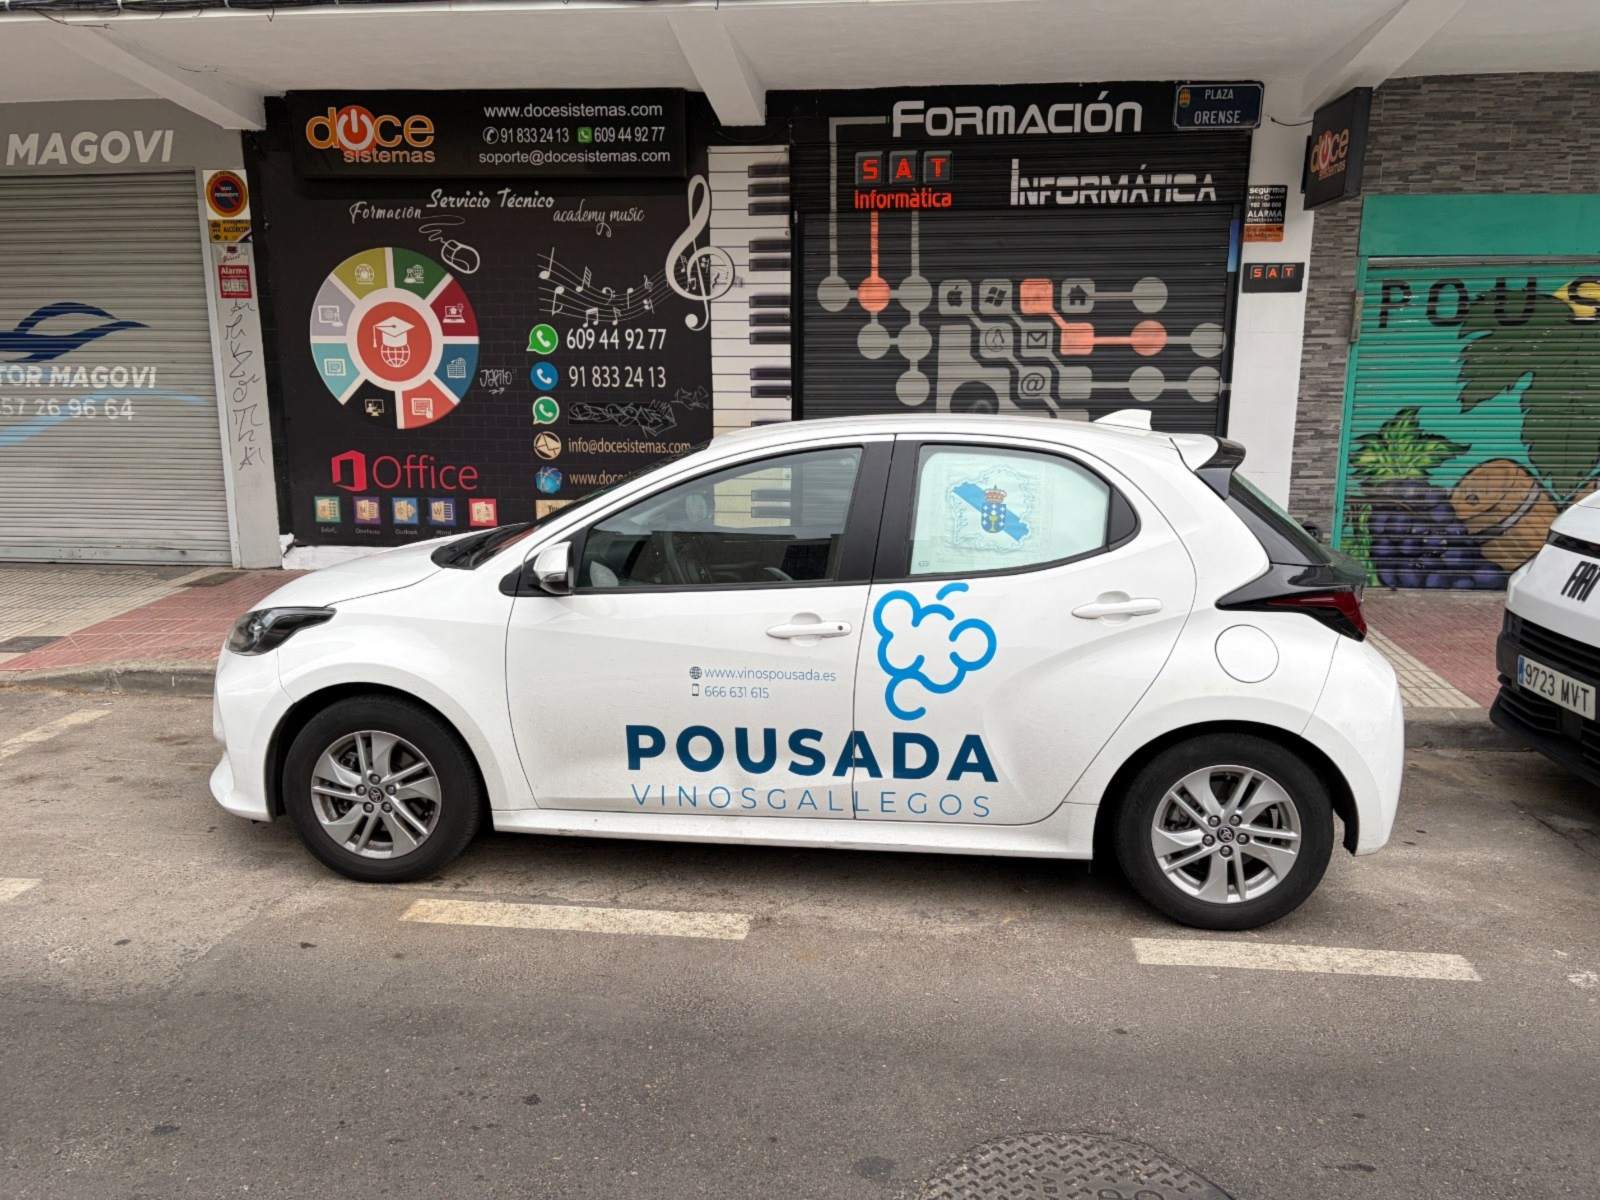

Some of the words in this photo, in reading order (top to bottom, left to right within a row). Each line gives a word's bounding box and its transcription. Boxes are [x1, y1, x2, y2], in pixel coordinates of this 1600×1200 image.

[1204, 88, 1234, 101] PLAZA
[483, 103, 663, 117] www.docesistemas.com
[892, 91, 1142, 137] FORMACIÓN
[1193, 110, 1242, 126] ORENSE
[500, 127, 514, 143] 91
[516, 127, 538, 143] 833
[539, 127, 554, 143] 24
[555, 127, 569, 143] 13
[594, 126, 616, 142] 609
[617, 126, 632, 142] 44
[634, 126, 649, 142] 92
[650, 126, 665, 142] 77
[6, 130, 174, 166] MAGOVI
[343, 149, 435, 163] sistemas
[479, 150, 670, 165] soporte@docesistemas.com
[1010, 158, 1218, 206] INFORMÁTICA
[426, 187, 490, 208] Servicio
[497, 188, 554, 208] Técnico
[553, 199, 612, 237] academy
[610, 207, 645, 222] music
[1247, 210, 1282, 218] ALARMA
[566, 329, 595, 350] 609
[599, 329, 620, 350] 44
[624, 329, 645, 350] 92
[647, 329, 667, 350] 77
[49, 366, 156, 389] MAGOVI
[569, 366, 587, 387] 91
[591, 366, 620, 387] 833
[624, 367, 643, 387] 24
[648, 367, 667, 387] 13
[36, 399, 60, 416] 26
[68, 398, 96, 419] 96
[104, 398, 136, 420] 64
[372, 454, 479, 490] Office
[704, 666, 837, 683] www.vinospousada.es
[704, 685, 727, 699] 666
[730, 685, 748, 699] 631
[750, 686, 770, 699] 615
[1525, 663, 1555, 696] 9723
[1561, 679, 1589, 712] MVT
[626, 724, 999, 783] POUSADA
